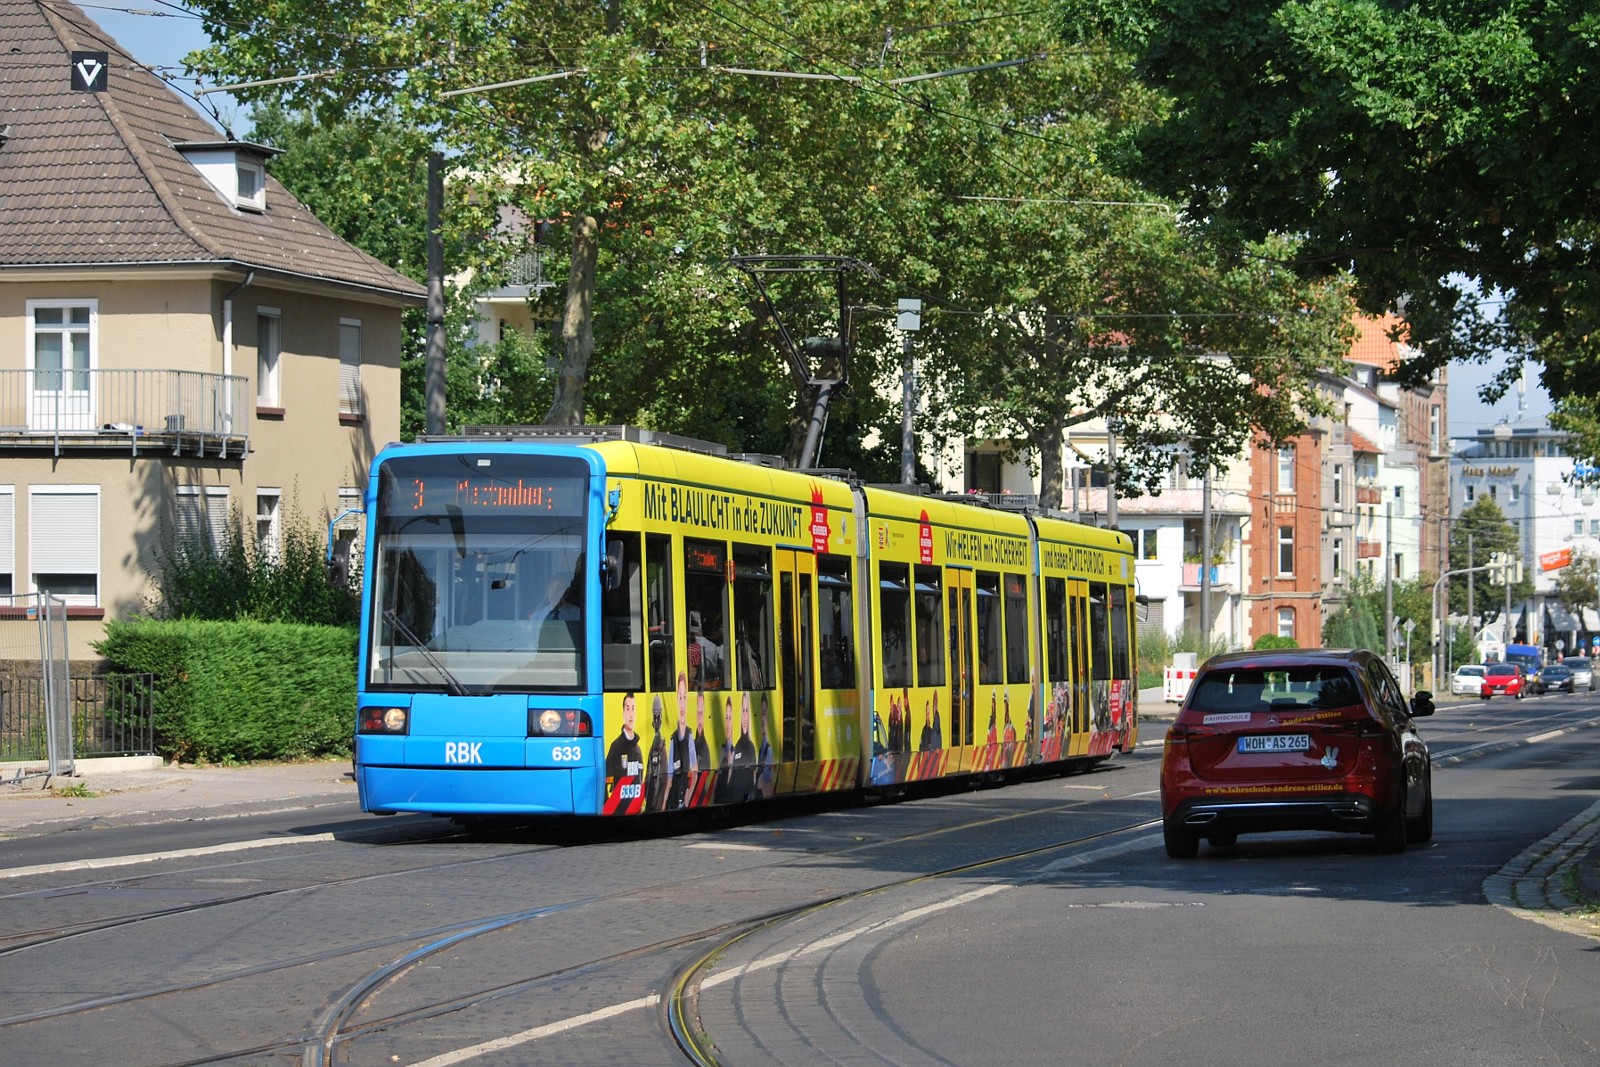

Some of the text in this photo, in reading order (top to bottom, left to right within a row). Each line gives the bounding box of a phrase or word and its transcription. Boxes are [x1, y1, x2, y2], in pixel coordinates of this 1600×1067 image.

[412, 479, 424, 510] 3
[644, 482, 802, 539] Mit BLAULICHT in die ZUKUNFT
[945, 530, 957, 558] Wir
[958, 532, 982, 562] HELFEN
[984, 536, 994, 563] mit
[994, 537, 1028, 566] SICHERHEIT
[1069, 547, 1083, 572] PLATZ
[1205, 713, 1249, 722] FAHRSCHULE
[1283, 711, 1342, 726] Andreas Stiller
[1245, 735, 1308, 750] WOH AS 265
[445, 742, 483, 764] RBK
[552, 746, 582, 761] 633
[627, 761, 639, 776] RBK
[1205, 783, 1344, 795] www.fahrschule-andreas-stiller.de
